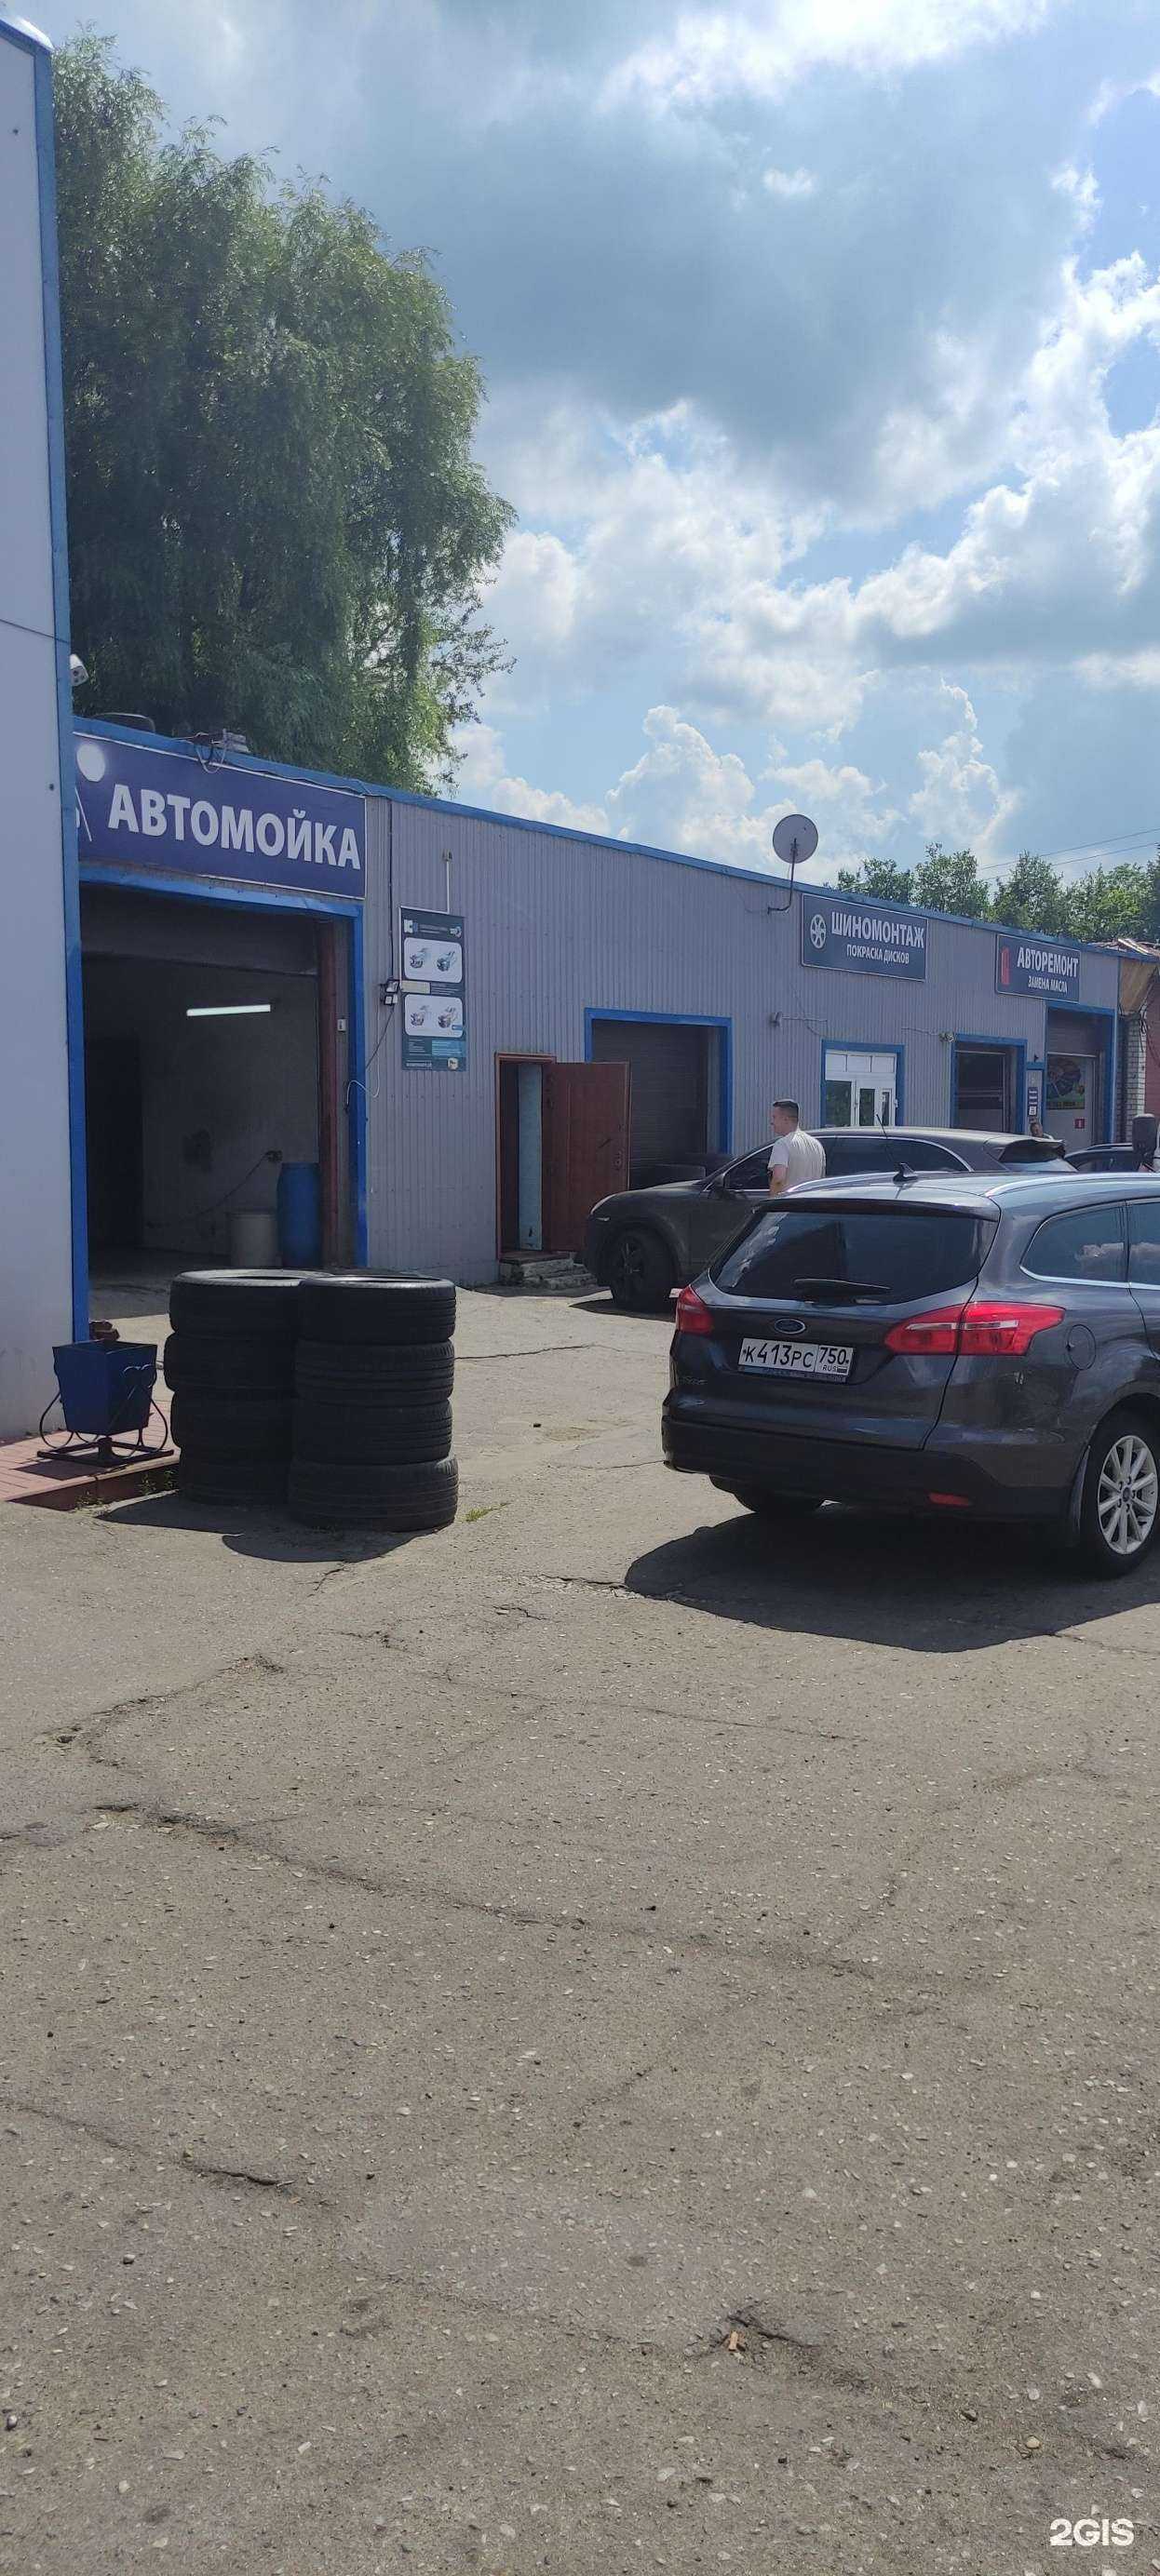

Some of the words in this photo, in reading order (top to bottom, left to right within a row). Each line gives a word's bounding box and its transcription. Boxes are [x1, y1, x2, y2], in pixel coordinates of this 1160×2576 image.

[108, 784, 361, 870] АВТОМОЙКА
[831, 911, 924, 948] ШИНОМОНТАЖ
[846, 944, 883, 961] ПОКРАСКА
[883, 948, 910, 964] ДИСКОВ
[1017, 946, 1079, 977] АВТОРЕМОНТ
[1028, 975, 1050, 990] ЗАМЕНА
[745, 1343, 815, 1368] К413РС
[819, 1346, 847, 1365] 750
